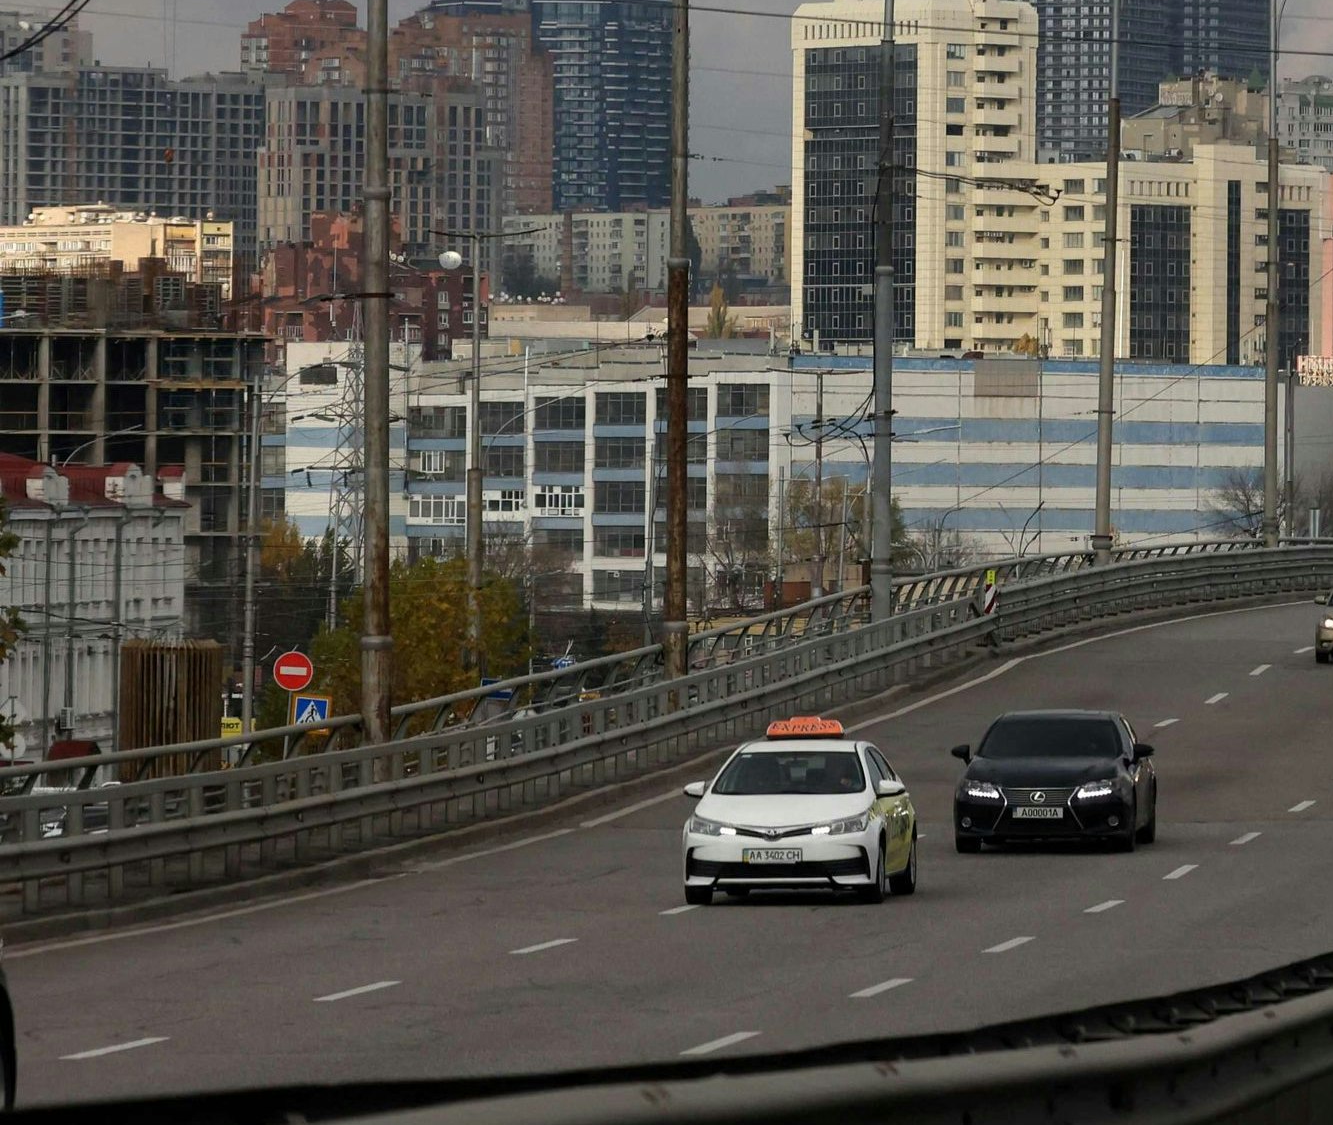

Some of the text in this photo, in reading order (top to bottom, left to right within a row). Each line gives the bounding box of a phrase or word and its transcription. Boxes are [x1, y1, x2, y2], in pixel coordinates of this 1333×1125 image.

[772, 722, 836, 732] EXPRESS
[764, 850, 785, 860] 3402
[786, 850, 800, 860] CH
